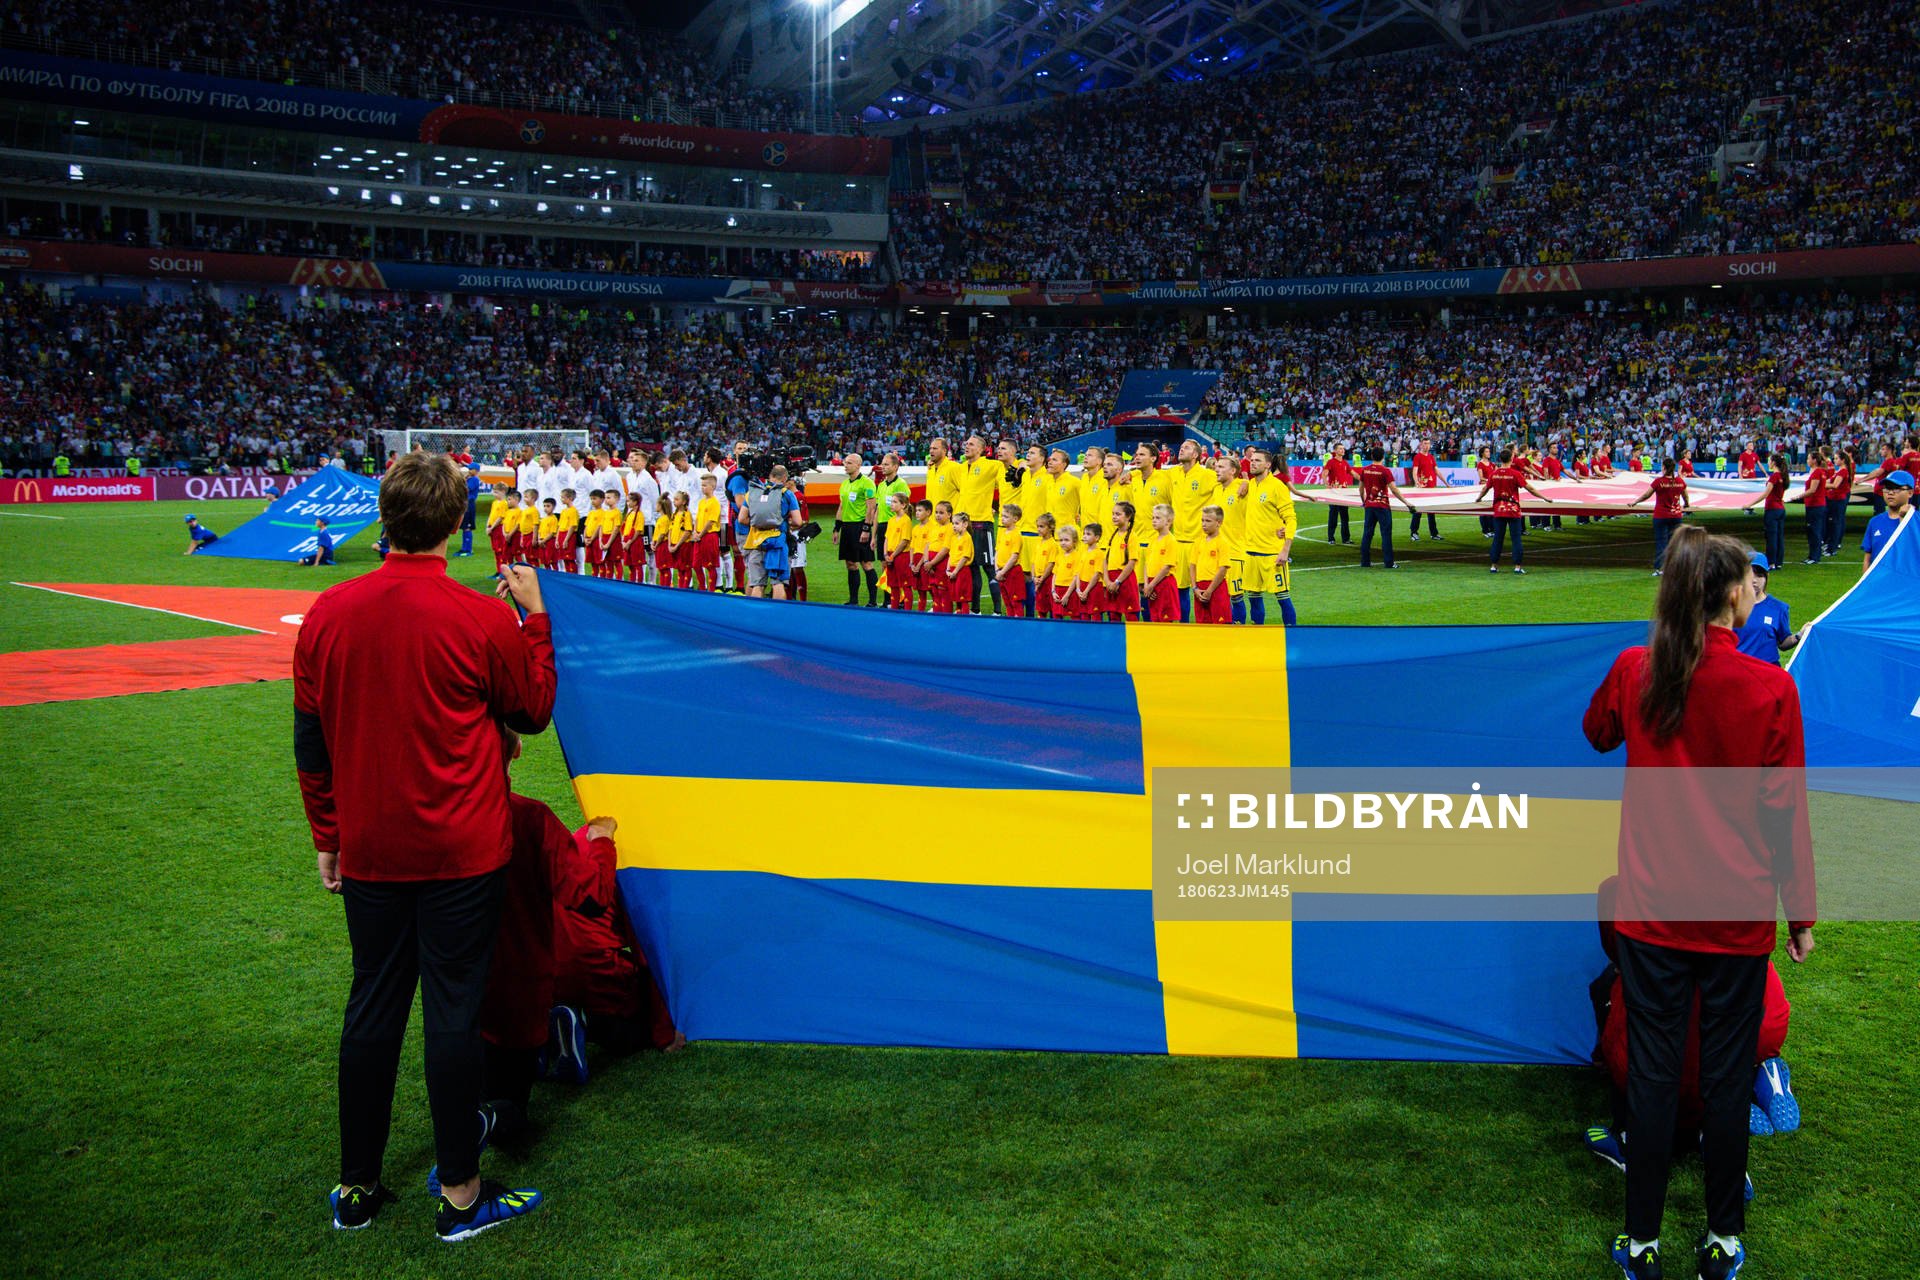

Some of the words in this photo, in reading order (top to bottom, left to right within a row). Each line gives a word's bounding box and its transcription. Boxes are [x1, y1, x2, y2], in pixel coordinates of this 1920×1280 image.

[0, 66, 65, 88] МИРА
[69, 74, 101, 93] ПО
[106, 79, 205, 105] ФУТБОЛУ
[208, 91, 251, 111] FIFA
[254, 97, 299, 116] 2018
[301, 102, 316, 118] В
[319, 104, 397, 126] РОССИИ
[617, 133, 696, 153] #worldcup
[148, 256, 204, 273] SOCHI
[1727, 261, 1777, 277] SOCHI
[457, 274, 492, 287] 2018
[493, 275, 524, 289] FIFA
[526, 276, 578, 292] WORLD
[579, 279, 610, 293] CUP
[611, 281, 664, 296] RUSSIA
[1255, 285, 1275, 297] ПО
[1278, 282, 1339, 297] ФУТБОЛУ
[1342, 281, 1371, 294] FIFA
[1373, 280, 1402, 293] 2018
[1404, 280, 1414, 291] В
[1416, 277, 1471, 291] РОССИИ
[52, 483, 142, 497] McDonald's
[1274, 574, 1283, 588] 9
